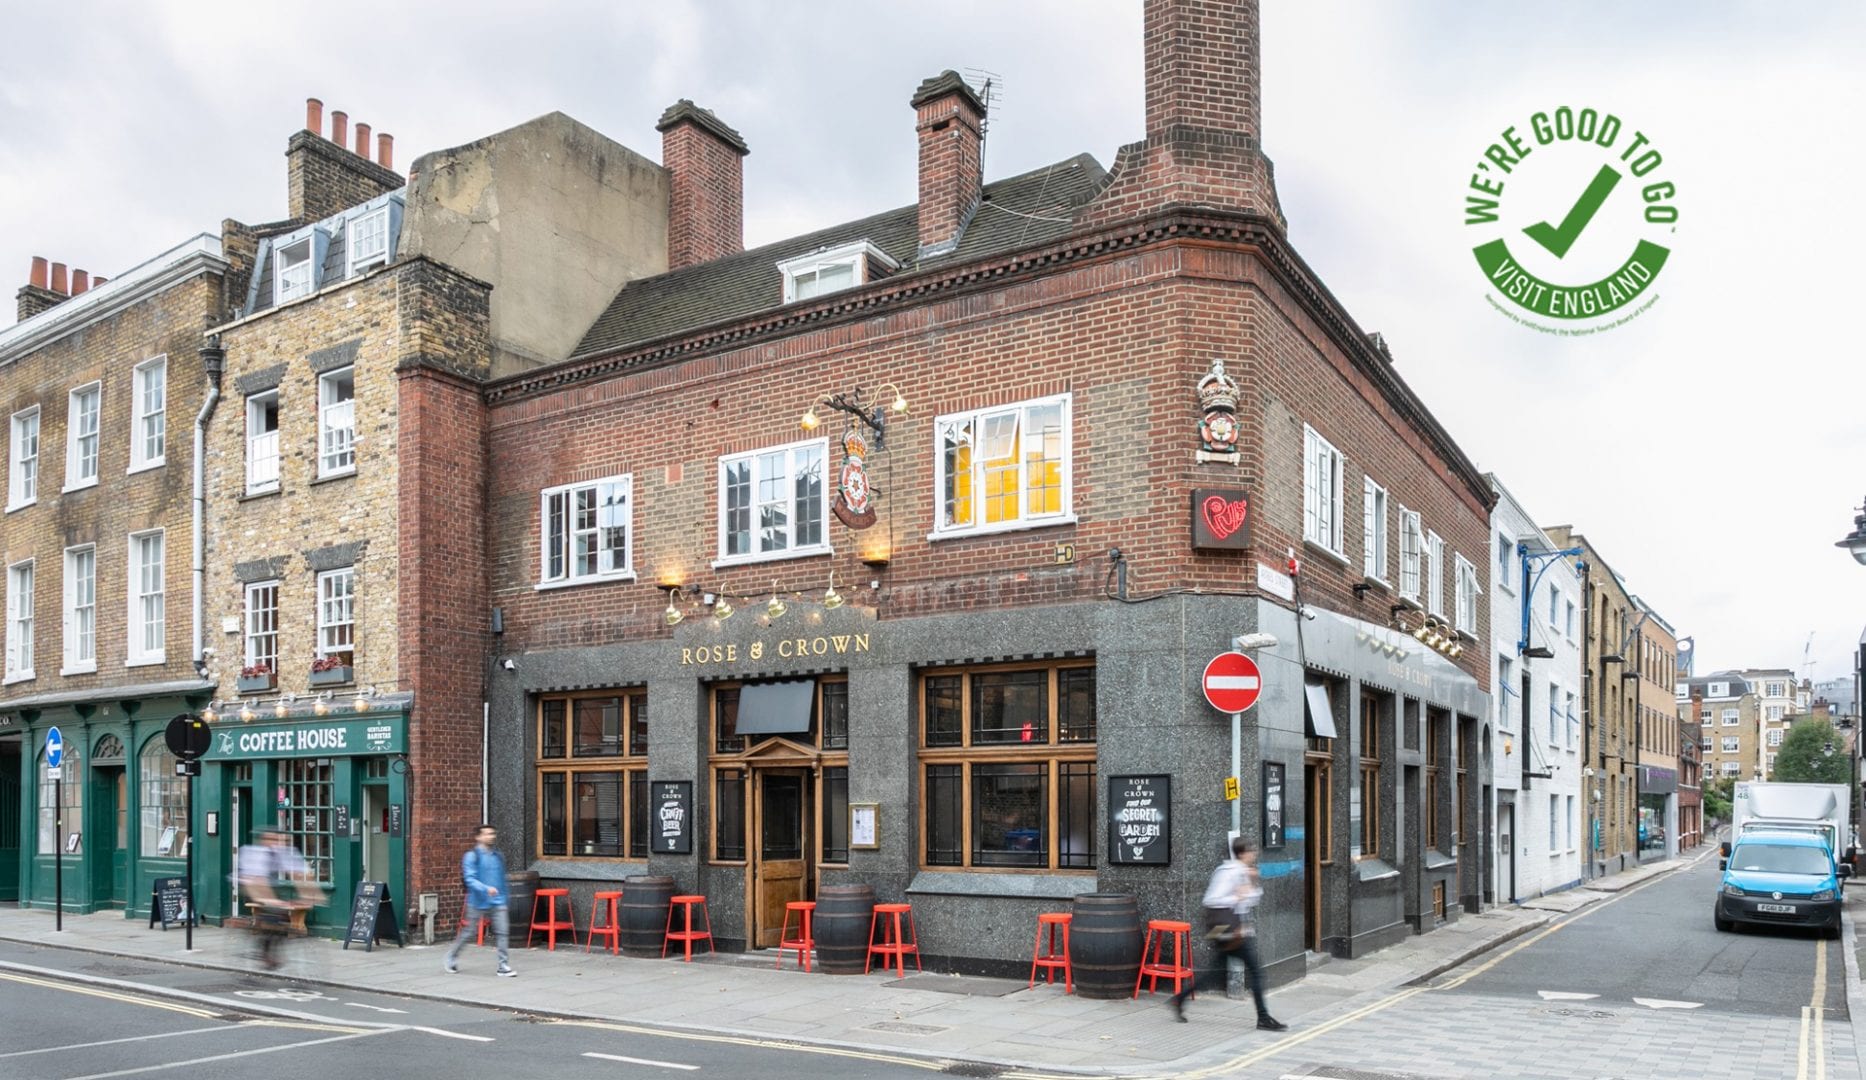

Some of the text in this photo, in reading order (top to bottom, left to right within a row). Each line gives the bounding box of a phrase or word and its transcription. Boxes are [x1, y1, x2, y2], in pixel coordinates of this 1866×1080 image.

[682, 633, 870, 665] ROSE & CROWN
[239, 731, 294, 752] COFFEE
[297, 727, 347, 750] HOUSE
[1227, 778, 1238, 797] H
[1122, 808, 1157, 822] SECRET
[663, 820, 680, 831] BEER
[1119, 824, 1160, 836] GARDEN
